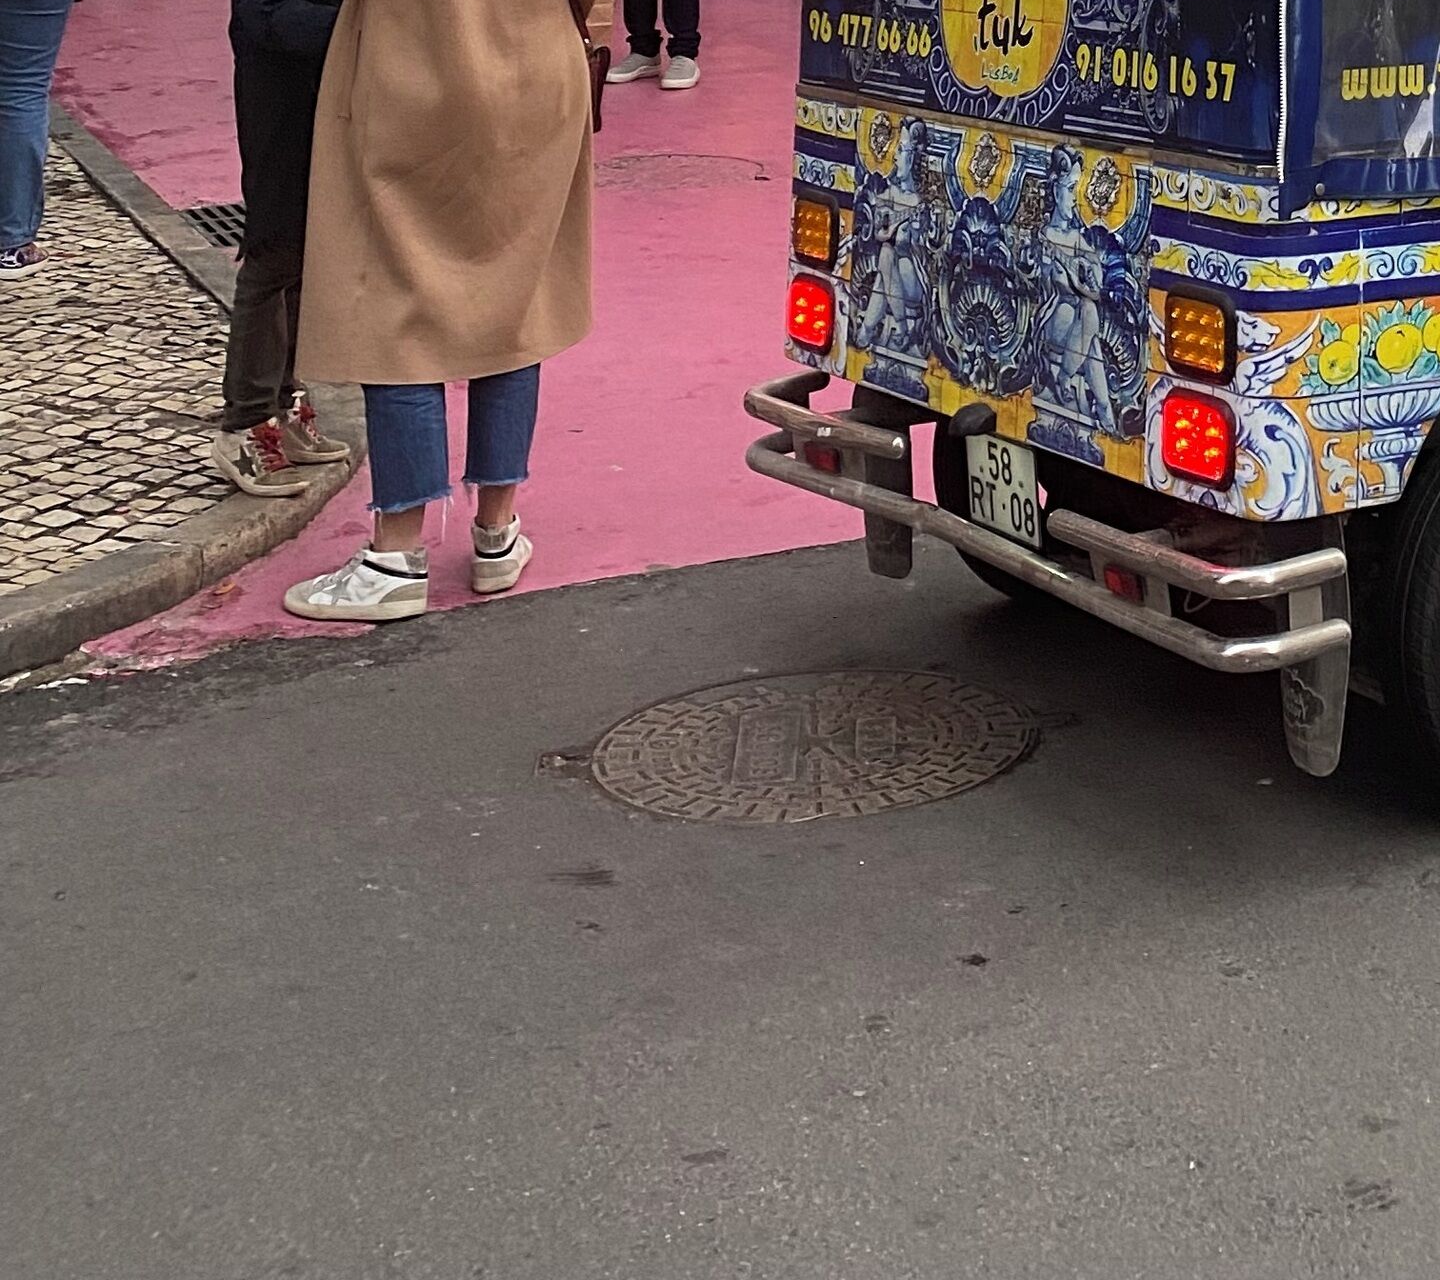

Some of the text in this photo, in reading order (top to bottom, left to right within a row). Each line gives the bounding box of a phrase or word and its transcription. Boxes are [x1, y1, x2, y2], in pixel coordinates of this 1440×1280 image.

[808, 9, 932, 58] 96 477 66 66
[1076, 43, 1236, 102] 91 016 16 37
[987, 441, 1013, 486] 58
